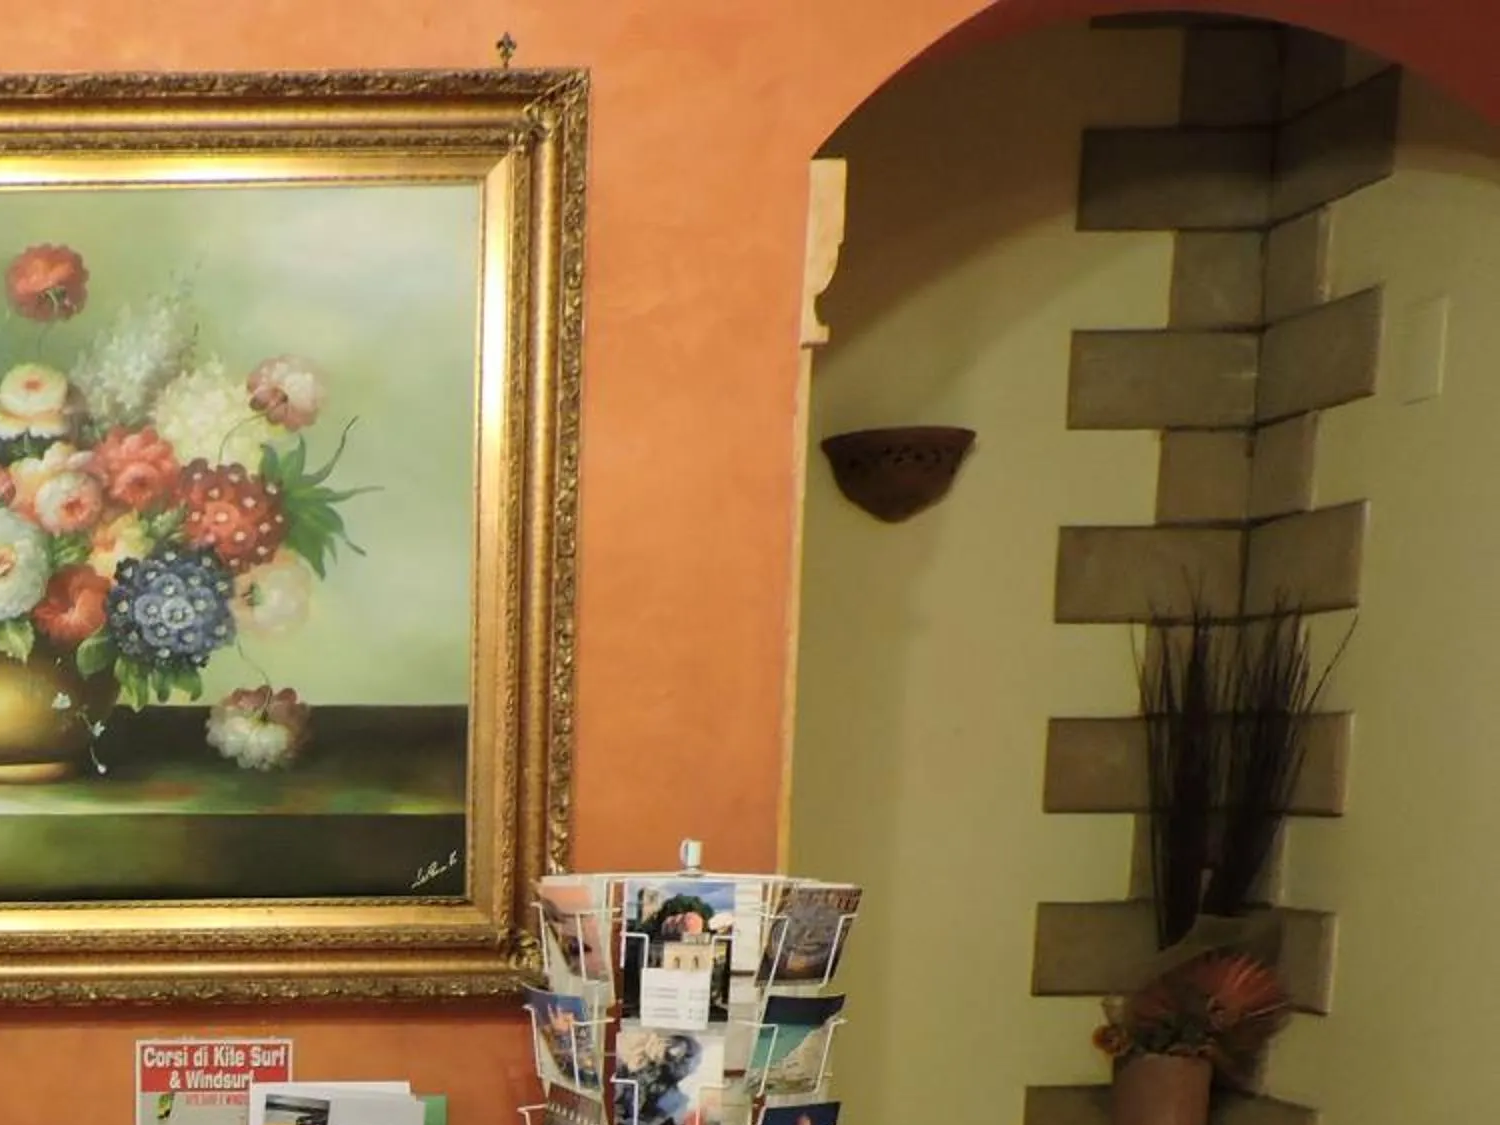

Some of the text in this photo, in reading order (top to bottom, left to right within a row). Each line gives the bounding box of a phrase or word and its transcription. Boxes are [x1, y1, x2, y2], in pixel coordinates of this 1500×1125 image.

[143, 1044, 286, 1067] Corsi di Kite Surf
[169, 1069, 255, 1089] & Windsurf
